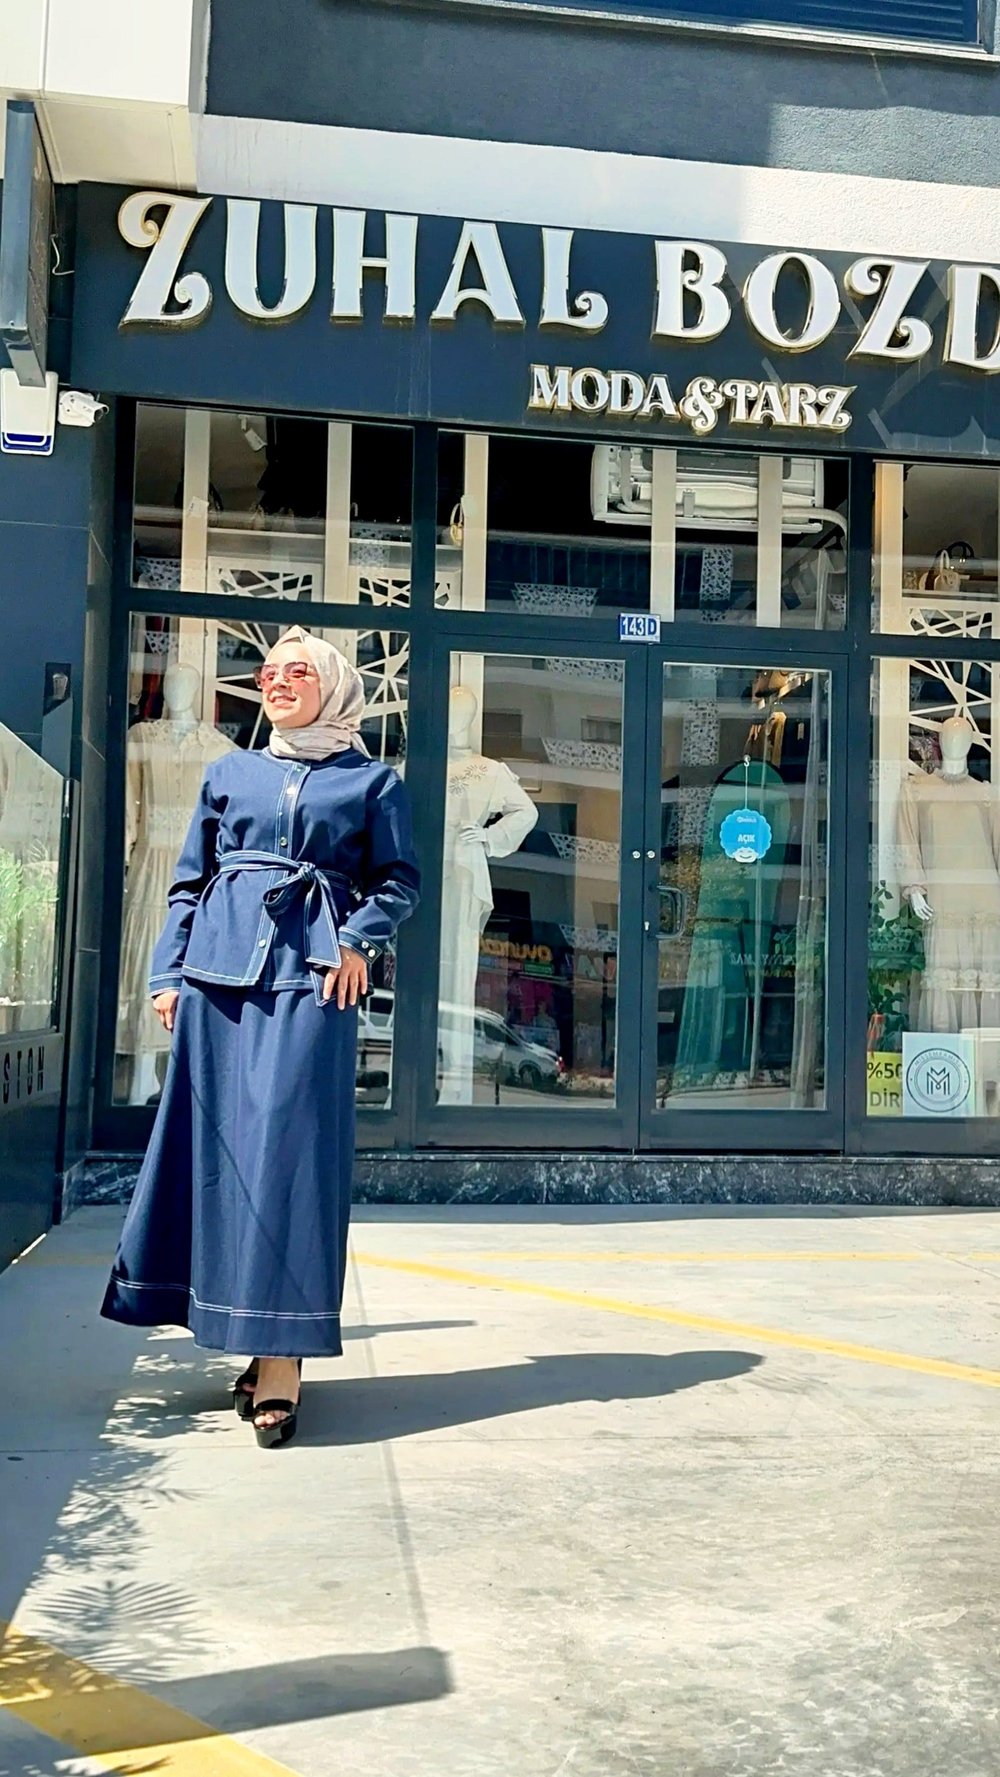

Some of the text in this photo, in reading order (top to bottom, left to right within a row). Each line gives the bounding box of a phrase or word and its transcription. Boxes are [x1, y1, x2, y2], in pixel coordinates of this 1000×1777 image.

[117, 191, 1000, 377] ZUHAL BOZD
[870, 1087, 903, 1107] DİR
